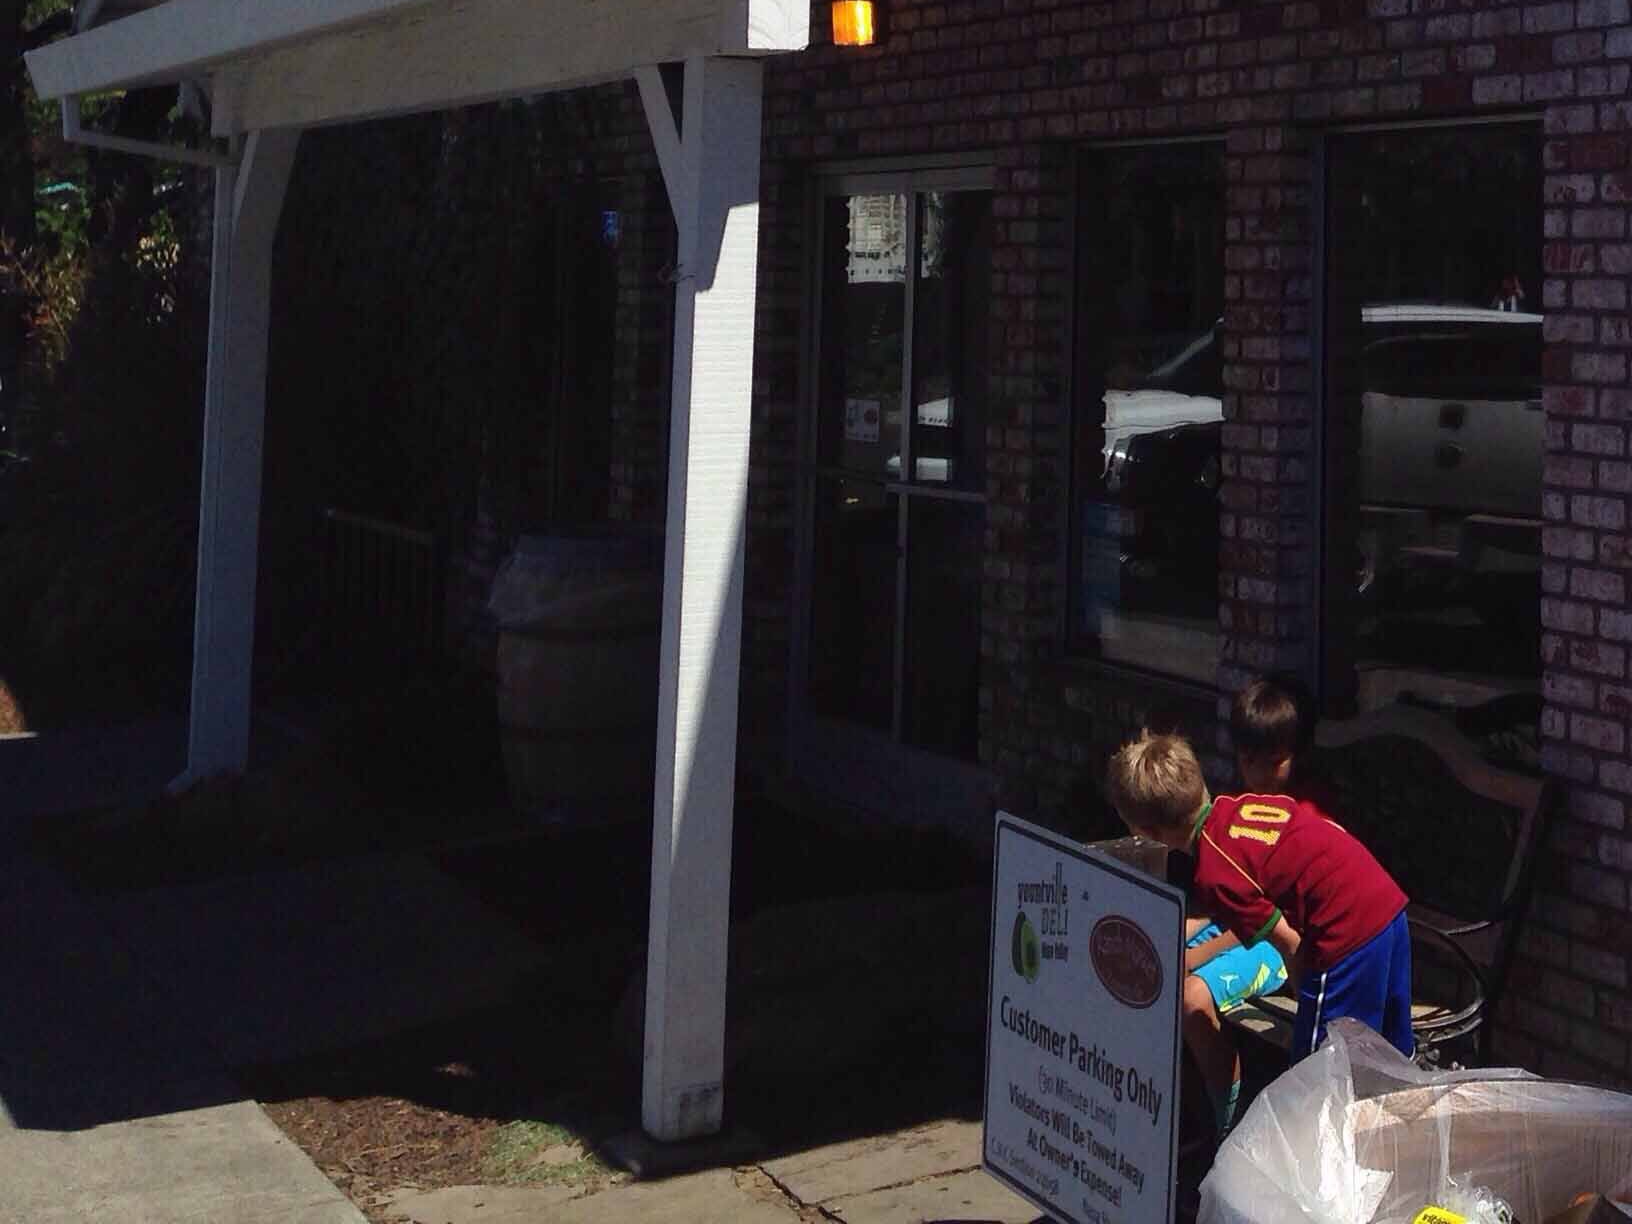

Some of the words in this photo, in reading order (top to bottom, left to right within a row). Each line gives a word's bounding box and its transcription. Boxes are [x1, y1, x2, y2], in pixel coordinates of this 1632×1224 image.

[1229, 803, 1291, 846] 10
[1000, 995, 1067, 1059] Customer
[1069, 1030, 1125, 1103] Parking
[1127, 1067, 1162, 1127] Only
[1008, 1081, 1050, 1127] Violators
[1051, 1107, 1071, 1140] Will
[1072, 1121, 1086, 1148] Be
[1086, 1129, 1118, 1171] Towed
[1118, 1152, 1145, 1196] Away
[1026, 1127, 1038, 1152] At
